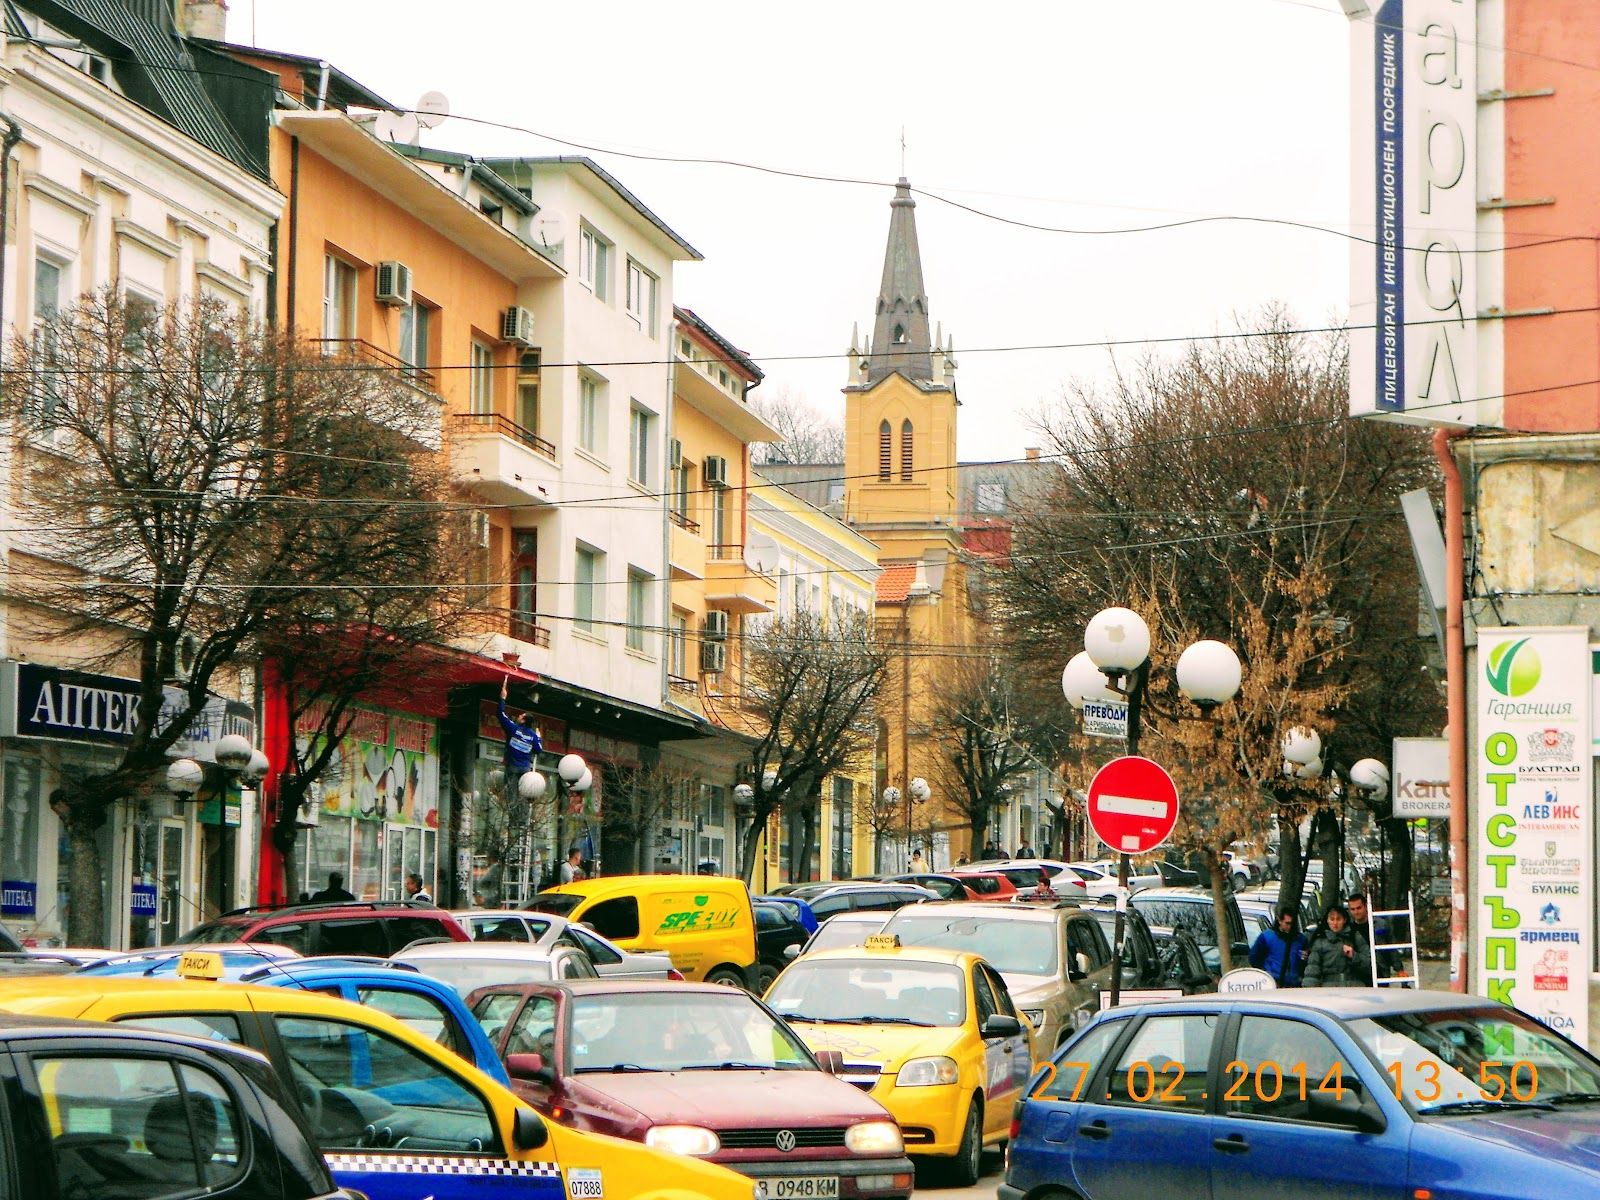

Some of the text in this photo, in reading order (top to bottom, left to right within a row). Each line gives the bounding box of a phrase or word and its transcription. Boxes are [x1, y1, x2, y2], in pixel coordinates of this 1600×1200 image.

[1416, 0, 1465, 403] арол
[1383, 33, 1398, 403] ЛИЦЕНЗИРАН ИНВЕСТИЦИОНЕН ПОСРЕДНИК
[30, 680, 142, 735] АПТЕК
[1487, 698, 1573, 721] Гаранция
[1523, 805, 1580, 819] ЛЕВ ИНС
[1531, 885, 1580, 894] БУЛ ИНС
[1520, 931, 1580, 944] армеец
[184, 957, 210, 970] ТАКСИ
[1532, 1016, 1575, 1029] NIQA
[571, 1181, 602, 1195] 07888
[777, 1180, 814, 1196] 0948
